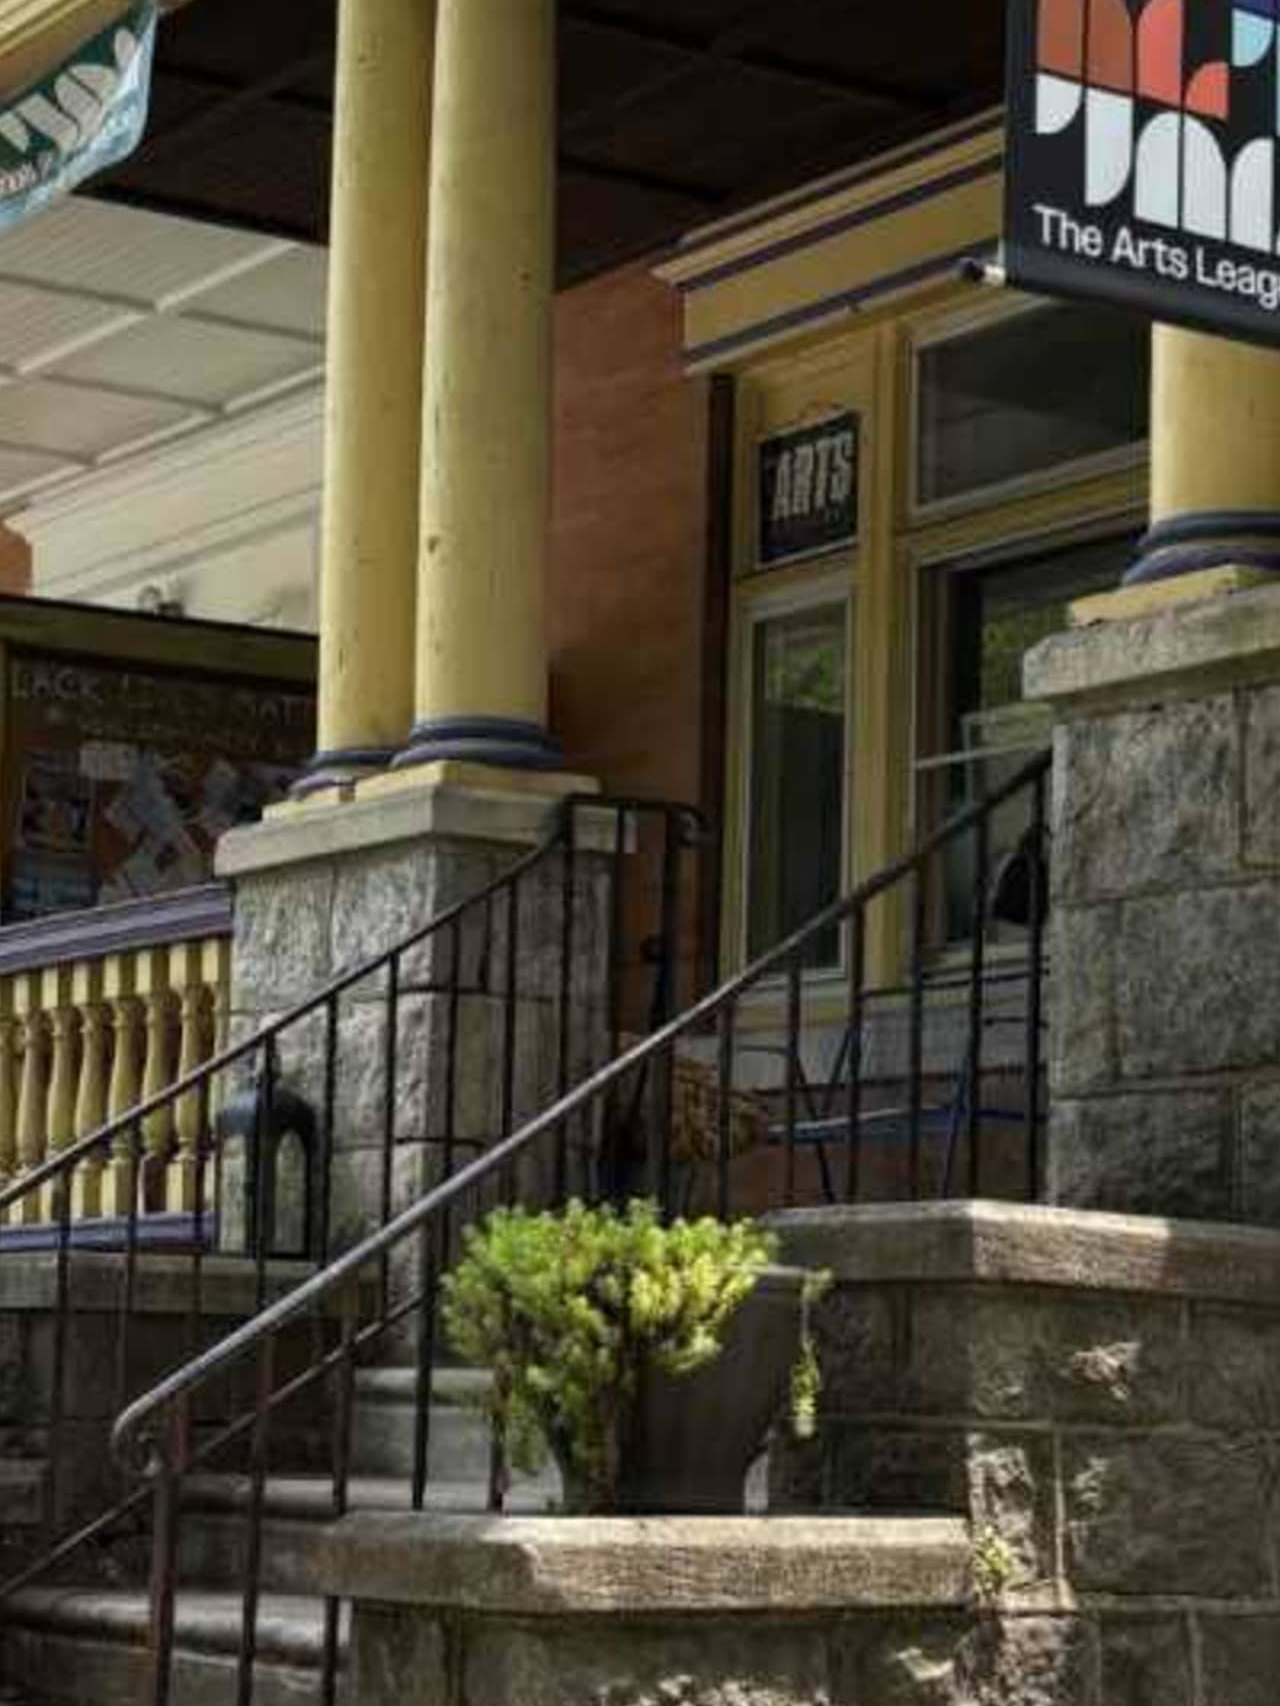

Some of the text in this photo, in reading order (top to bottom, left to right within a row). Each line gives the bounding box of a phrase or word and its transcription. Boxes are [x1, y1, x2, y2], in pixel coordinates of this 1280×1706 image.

[1032, 203, 1103, 257] The
[1110, 227, 1189, 279] Arts
[772, 431, 853, 521] ARTS
